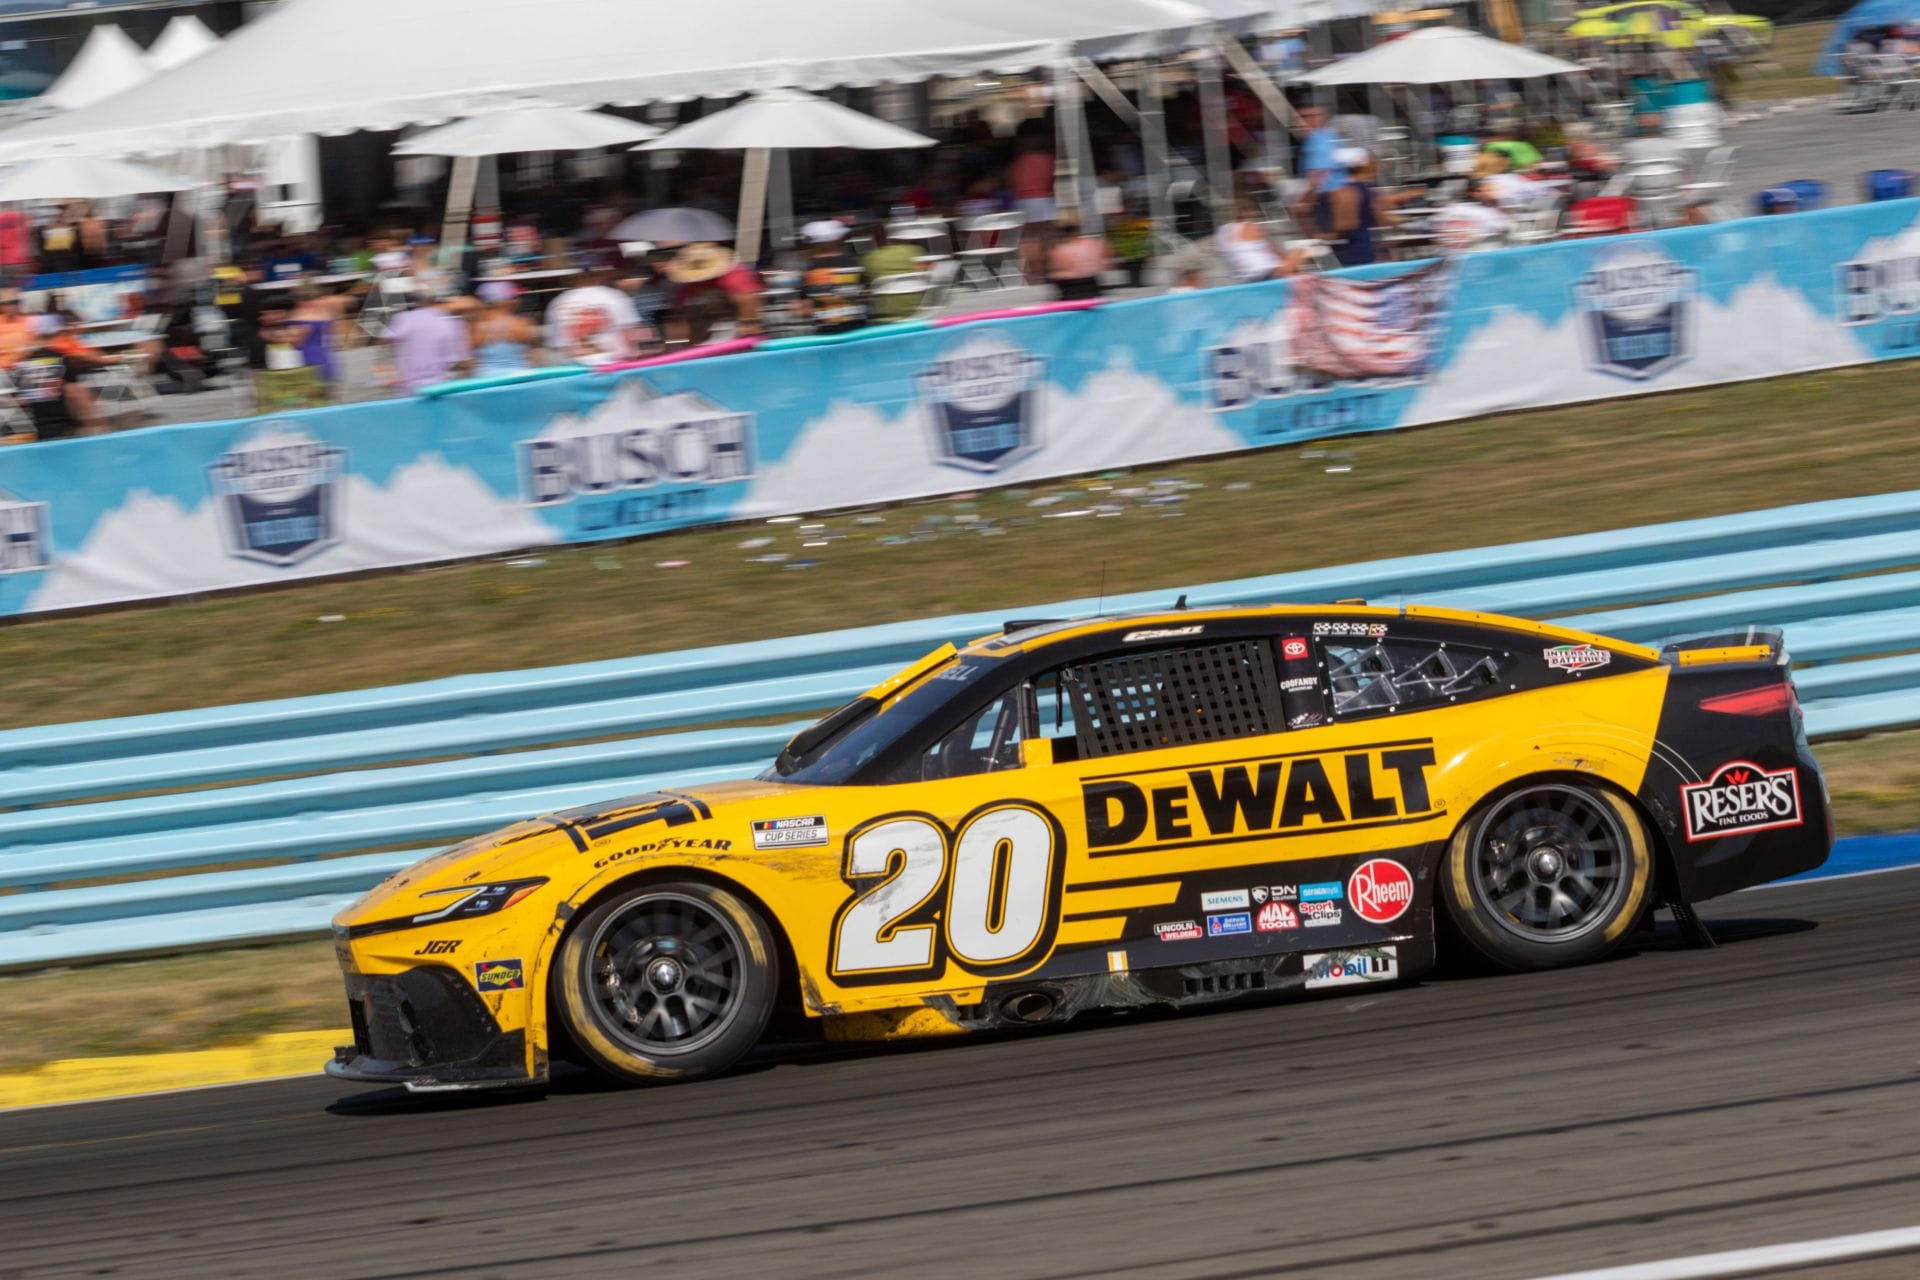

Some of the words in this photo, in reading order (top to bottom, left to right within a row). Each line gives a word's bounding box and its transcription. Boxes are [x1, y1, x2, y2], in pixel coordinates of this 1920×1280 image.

[521, 416, 754, 506] BUSCH
[1691, 776, 1792, 832] RESER'S
[776, 818, 815, 829] NASCAR
[1719, 816, 1738, 826] FINE
[1740, 811, 1769, 823] FOODS
[764, 832, 784, 842] CUP
[784, 829, 817, 840] SERIES
[593, 836, 732, 868] GOODYEAR
[1270, 884, 1297, 896] DN
[1355, 863, 1409, 913] Rheem
[827, 802, 1067, 988] 20
[1207, 895, 1244, 905] SIEMENS
[1260, 900, 1296, 923] MAC
[1300, 901, 1332, 913] Sport
[1312, 909, 1341, 921] Clips
[1156, 922, 1194, 933] LINCOLN
[1260, 920, 1297, 930] TOOLS
[1163, 929, 1199, 939] WELDERS
[414, 940, 463, 955] JGR
[480, 969, 521, 982] SUNOCO
